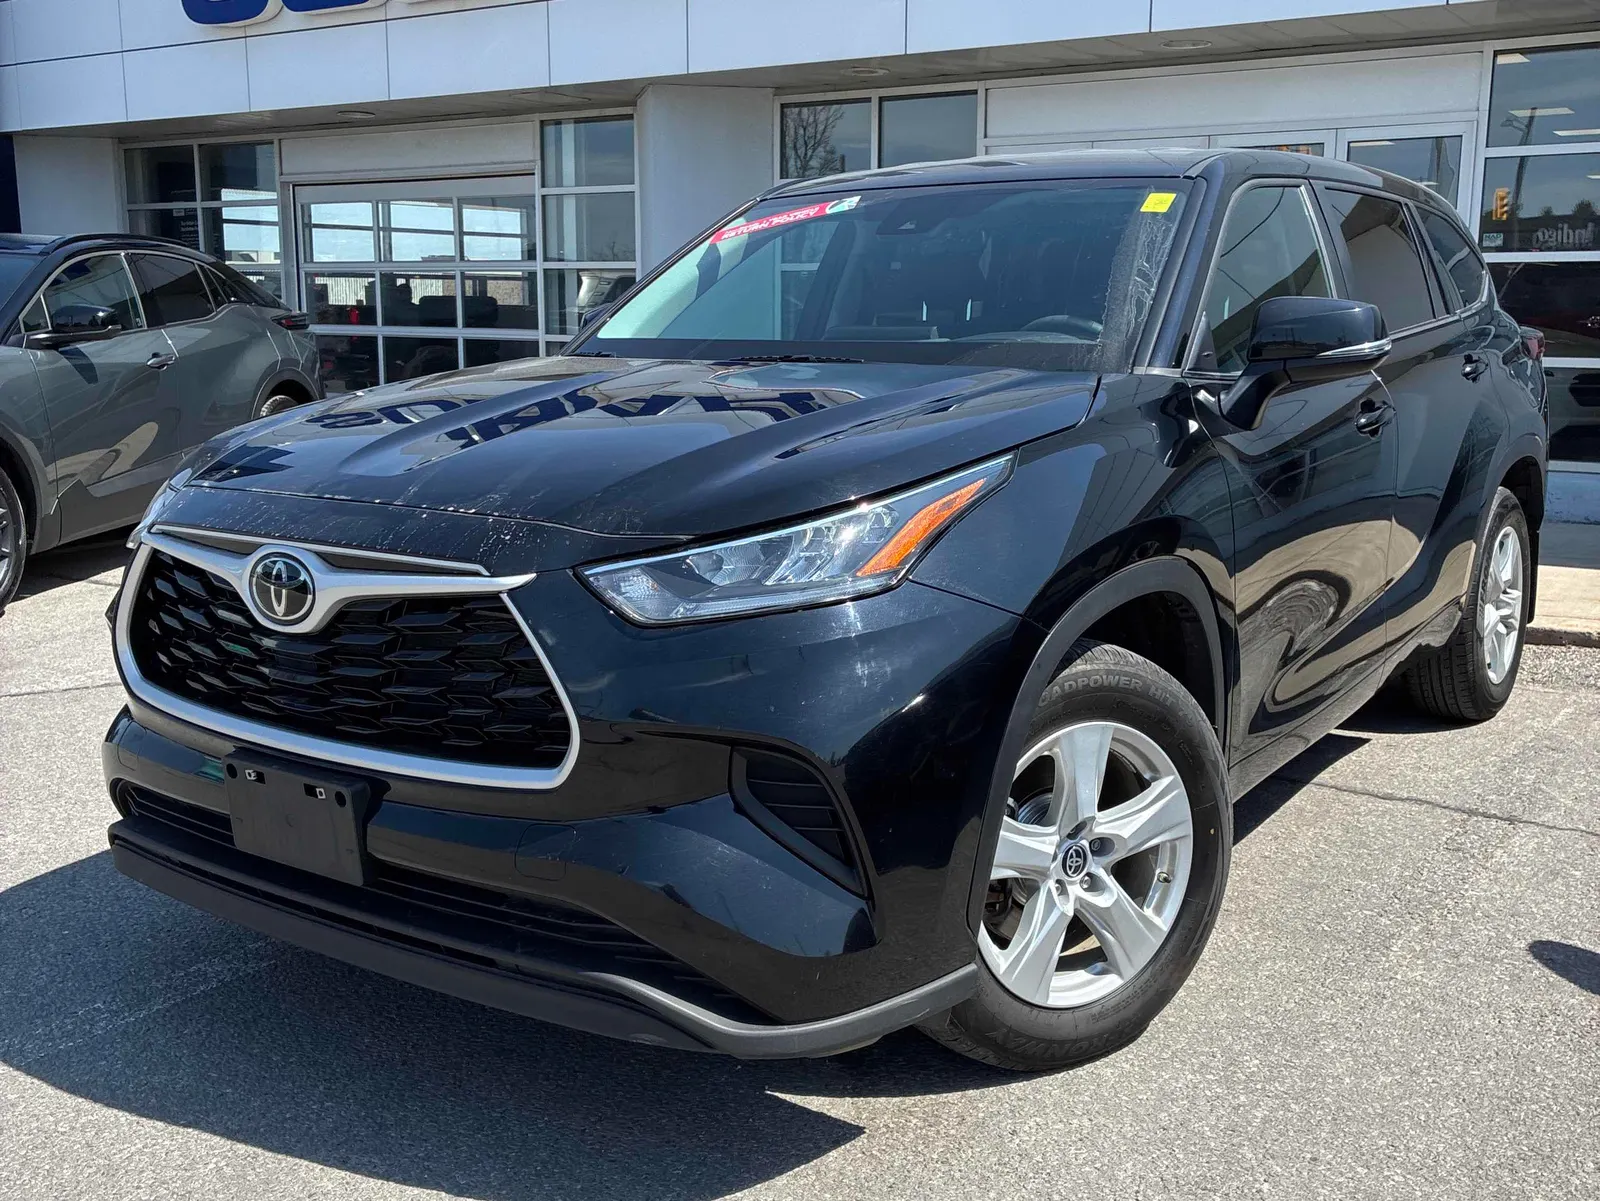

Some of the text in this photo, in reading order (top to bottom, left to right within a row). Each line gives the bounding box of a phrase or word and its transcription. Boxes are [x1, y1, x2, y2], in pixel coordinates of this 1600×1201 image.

[721, 222, 769, 239] RETURN
[771, 207, 820, 225] POLICY
[1038, 675, 1143, 707] OADPOWER
